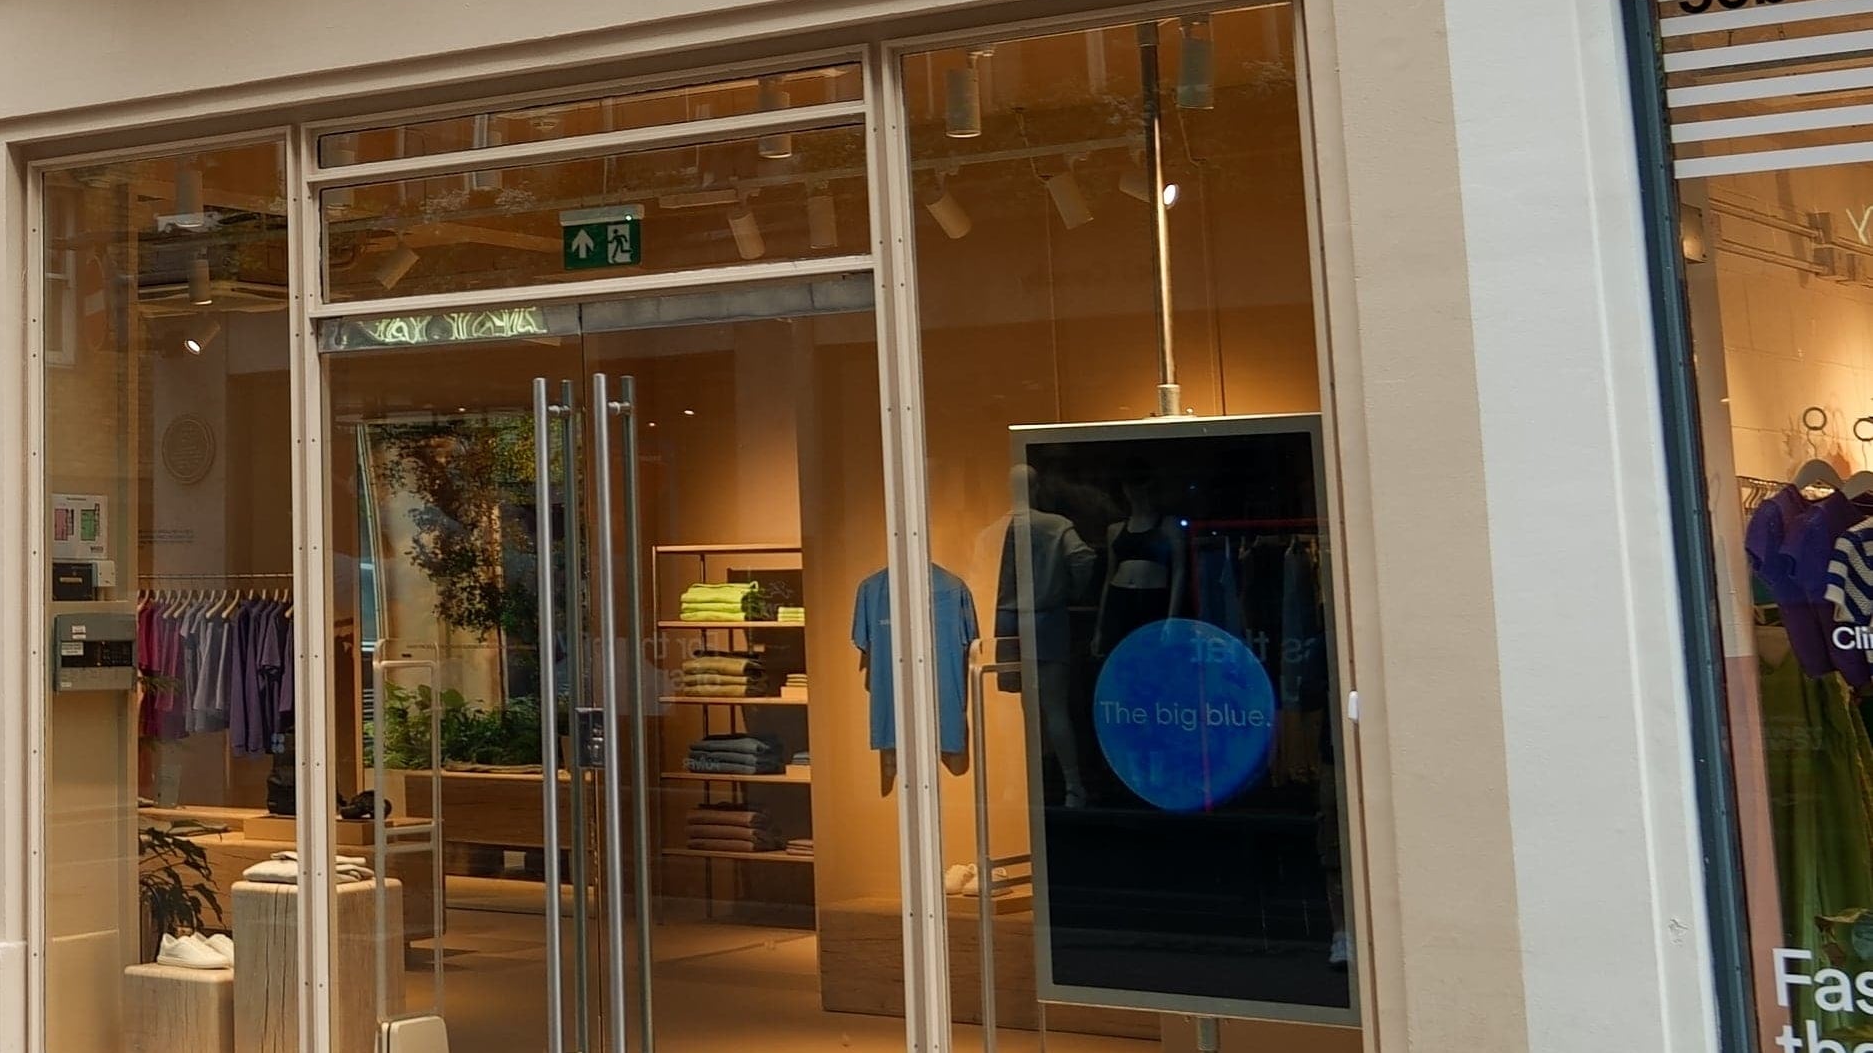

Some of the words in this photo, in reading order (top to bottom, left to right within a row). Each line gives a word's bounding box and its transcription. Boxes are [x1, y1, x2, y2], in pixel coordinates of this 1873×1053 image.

[1832, 625, 1873, 650] Cli
[1099, 700, 1149, 726] The
[1155, 702, 1198, 732] big
[1205, 701, 1272, 729] blue.
[1774, 1019, 1873, 1053] th
